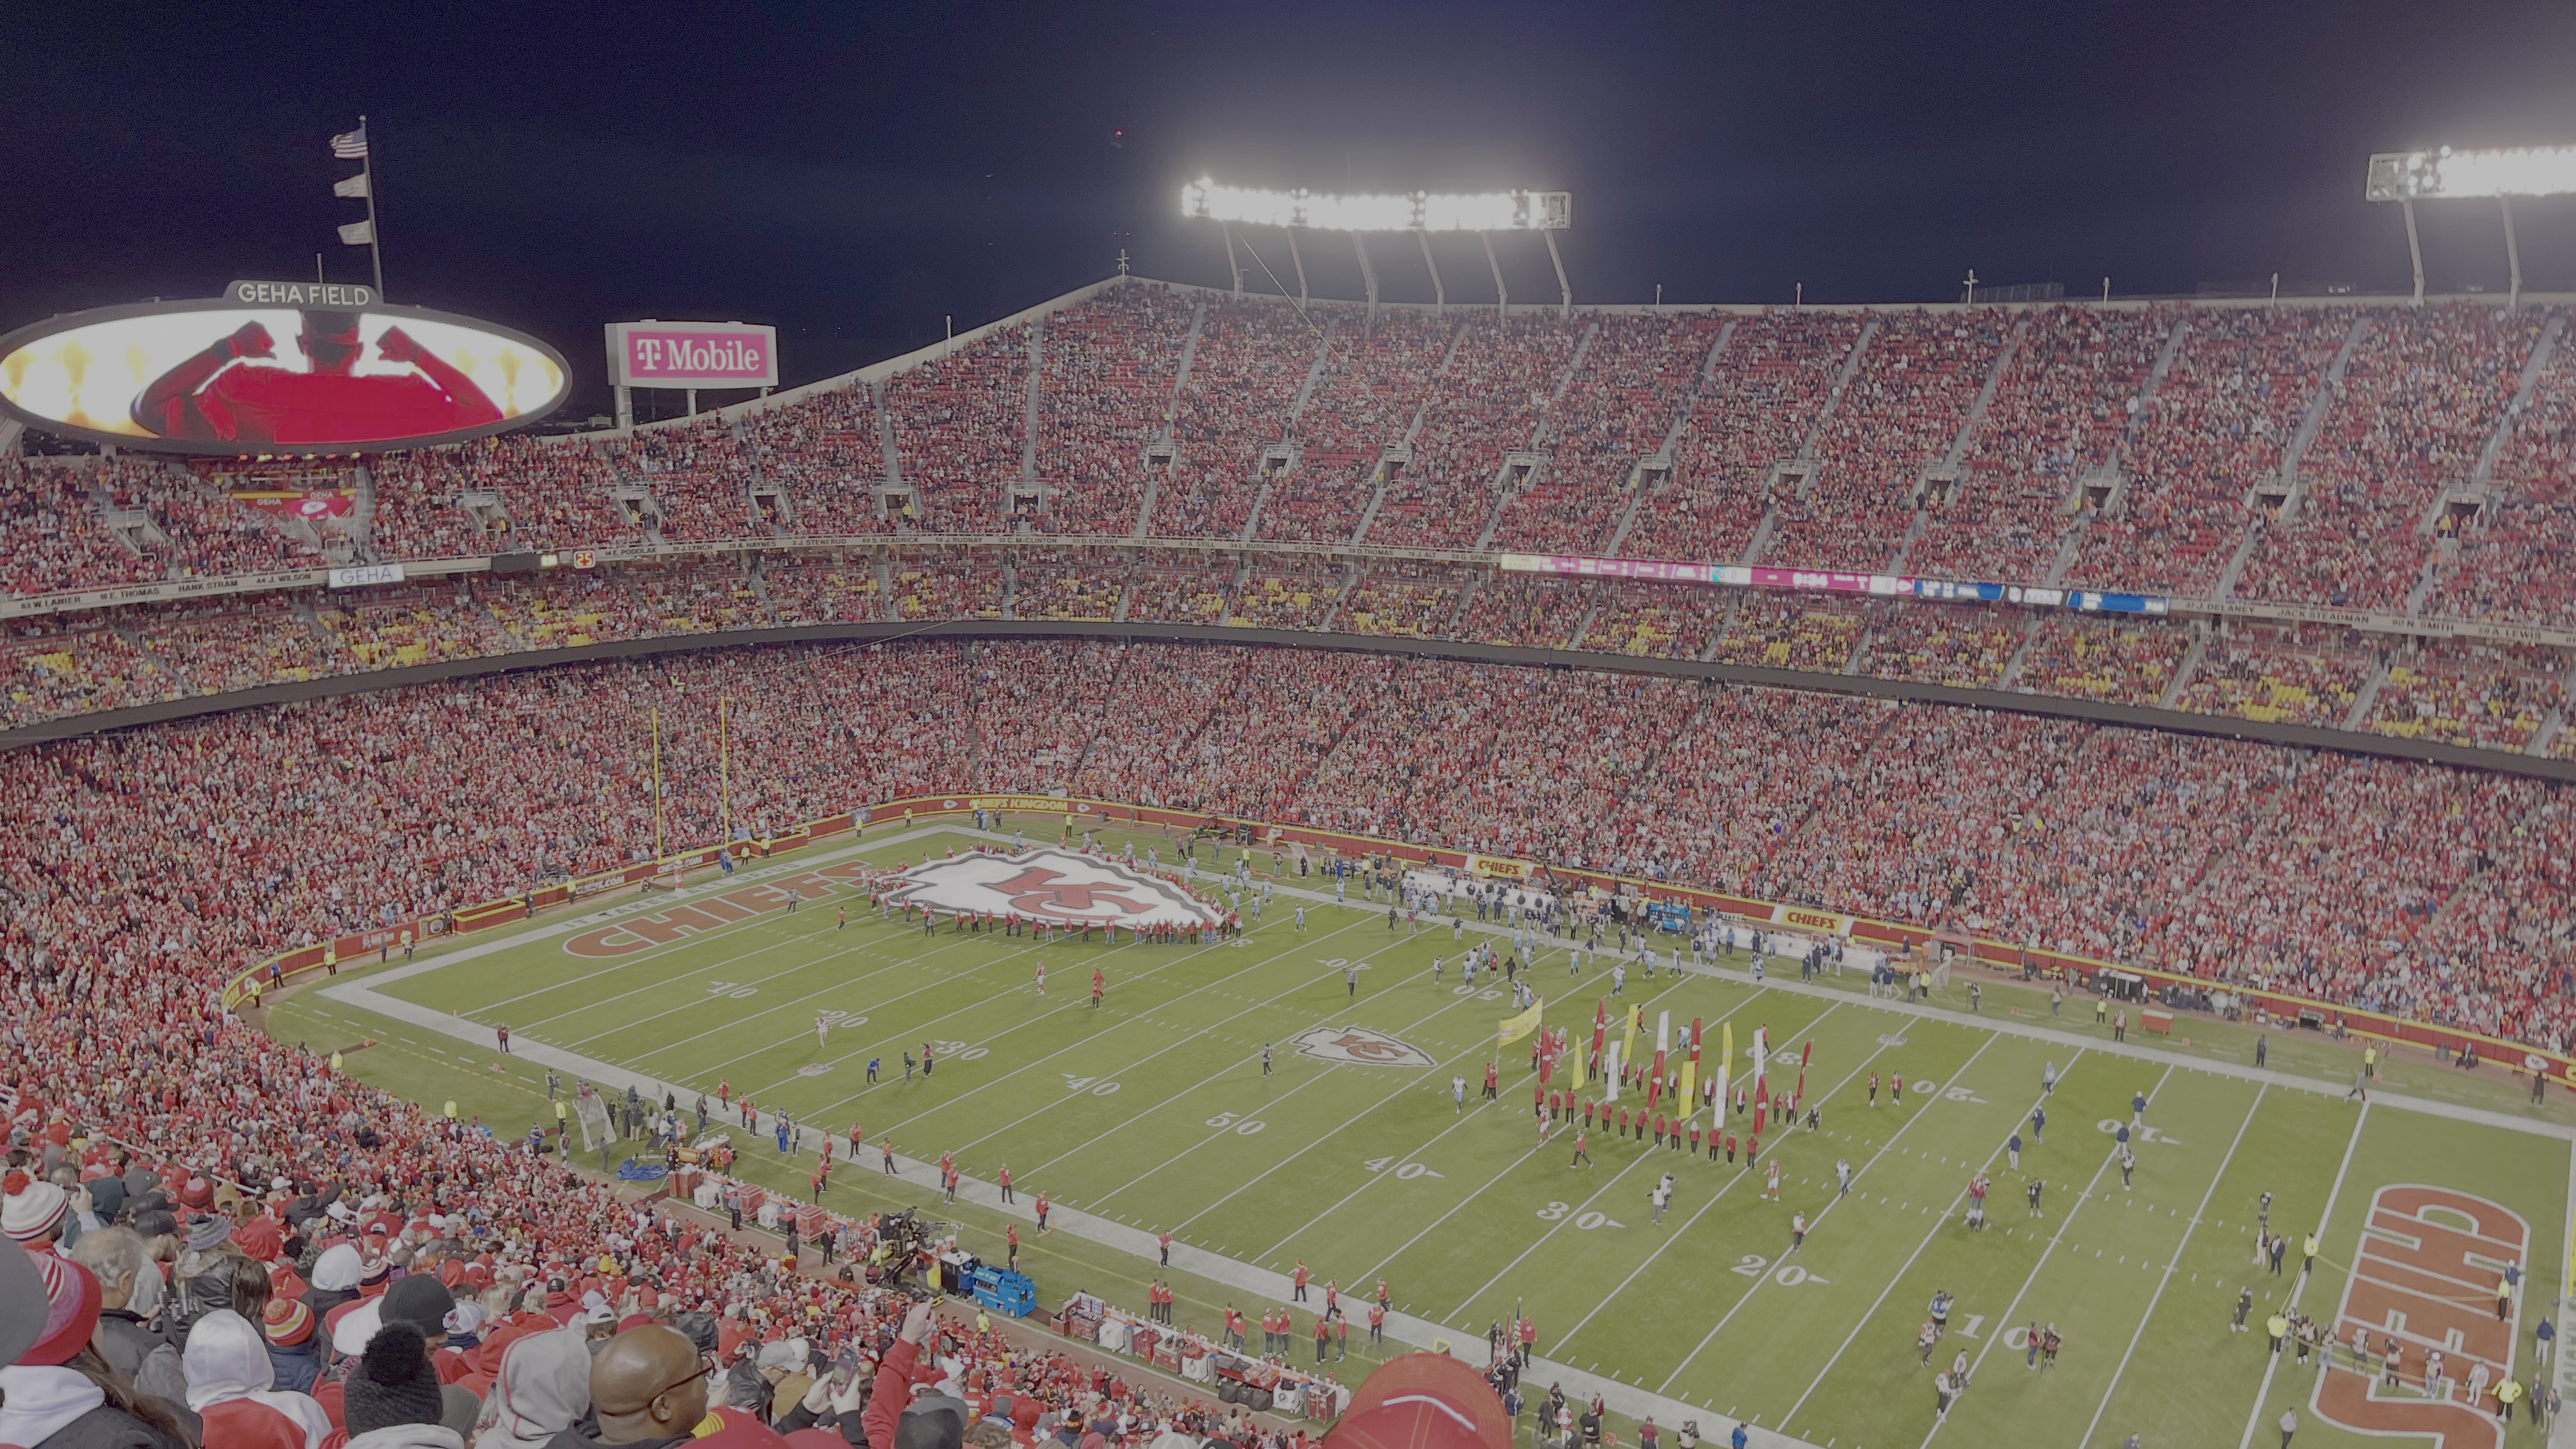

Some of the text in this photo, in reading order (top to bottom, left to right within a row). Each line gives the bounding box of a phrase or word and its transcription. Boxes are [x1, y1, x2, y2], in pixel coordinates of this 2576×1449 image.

[237, 283, 369, 306] GEHA FIELD
[665, 339, 760, 371] Mobile
[256, 497, 282, 506] GEHA
[621, 547, 657, 556] PODOLAK
[278, 573, 311, 582] WILSON
[340, 567, 394, 584] GEHA
[120, 587, 160, 599] THOMAS
[178, 579, 239, 592] HANK STRAM
[45, 596, 81, 607] LANIER
[2207, 603, 2255, 615] DELANEY
[2277, 608, 2369, 623] JACK STEADMAN
[1010, 799, 1069, 811] KINGDOM
[1479, 860, 1520, 875] CHIEFS
[563, 862, 801, 927] IT TAKES ALL OF US
[1787, 912, 1837, 929] CHIEFS
[705, 982, 758, 999] 10
[934, 1040, 989, 1060] 30
[1065, 1076, 1121, 1096] 40
[1205, 1111, 1266, 1136] 50
[1363, 1155, 1426, 1179] 40
[1536, 1201, 1606, 1230] 30
[1731, 1254, 1807, 1286] 20
[1954, 1313, 2032, 1351] 10
